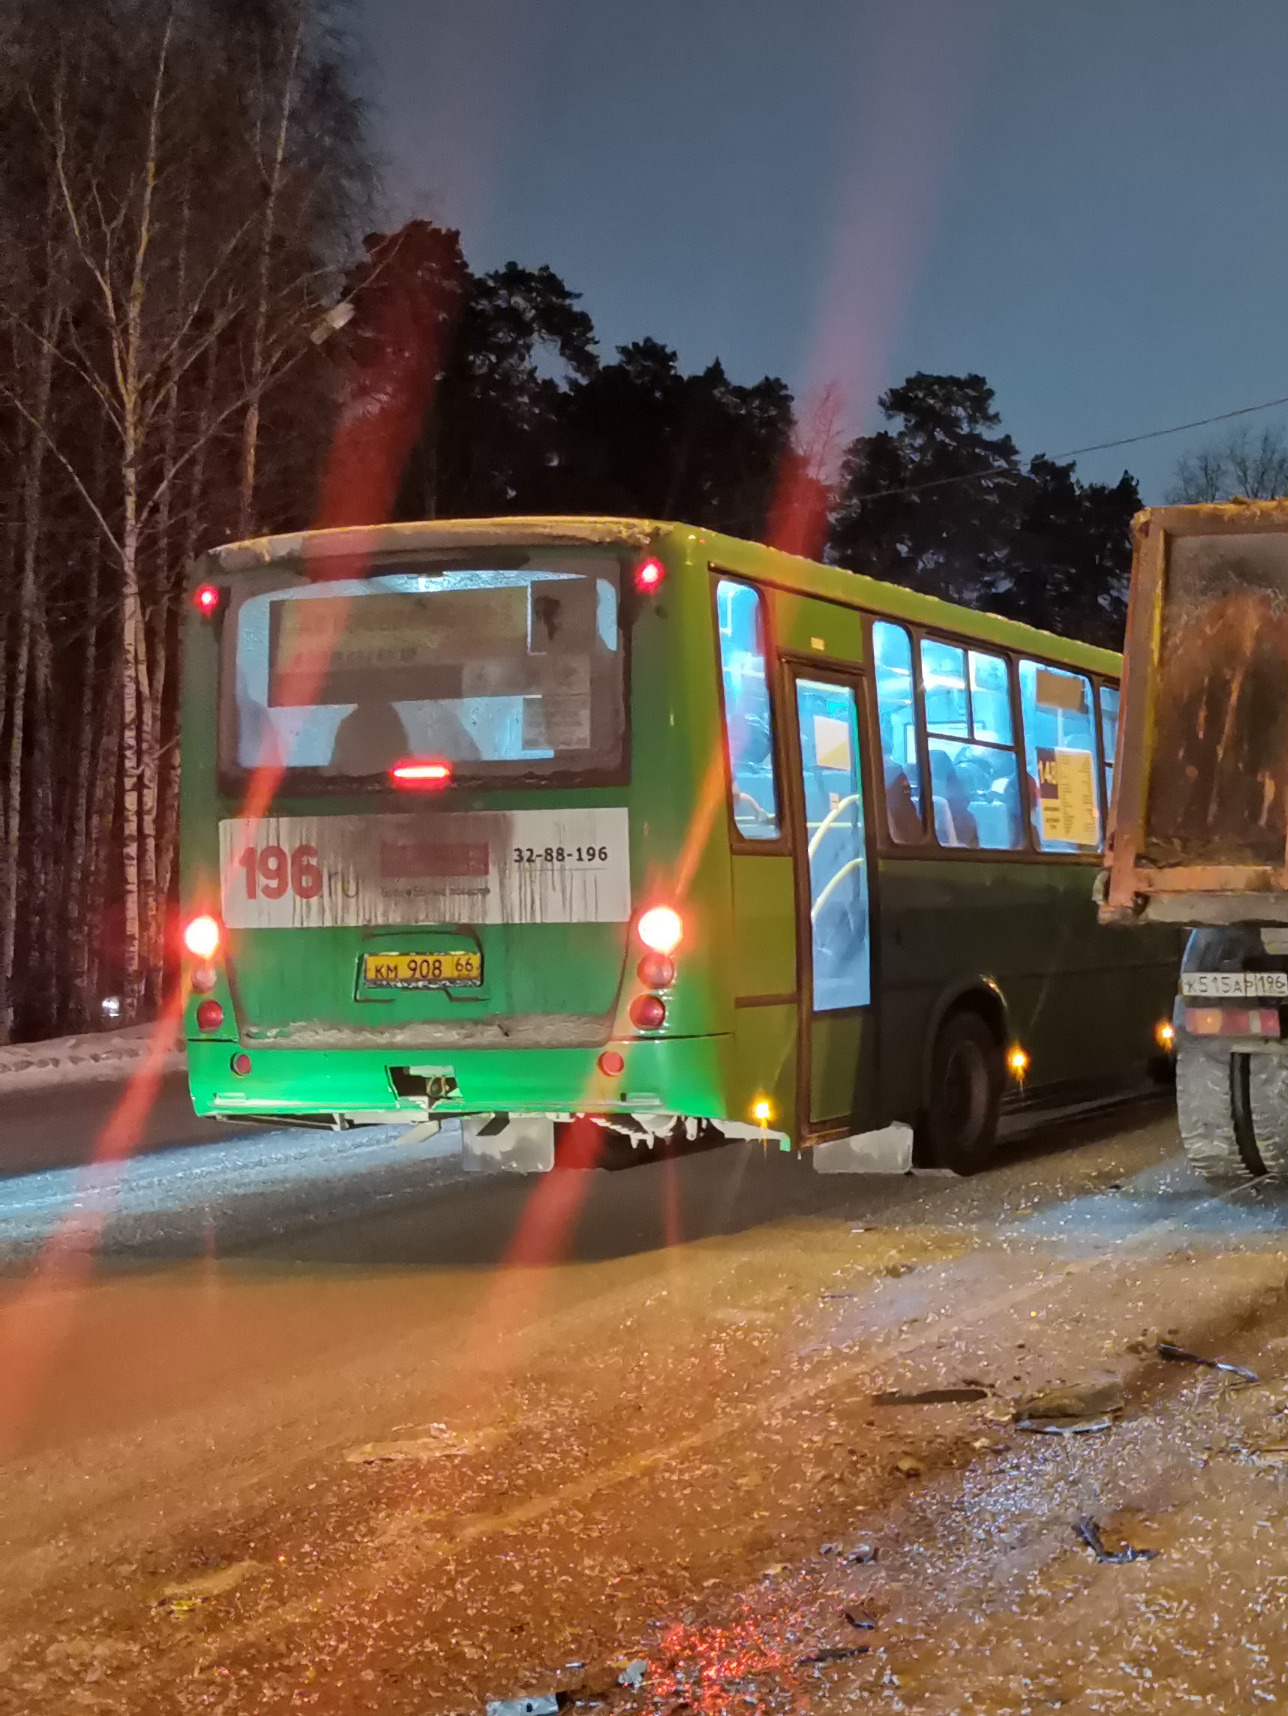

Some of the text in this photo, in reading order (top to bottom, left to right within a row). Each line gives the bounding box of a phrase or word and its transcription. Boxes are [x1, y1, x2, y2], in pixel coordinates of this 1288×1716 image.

[513, 846, 609, 864] 32-88-196
[406, 959, 443, 979] 908
[455, 957, 474, 972] 66
